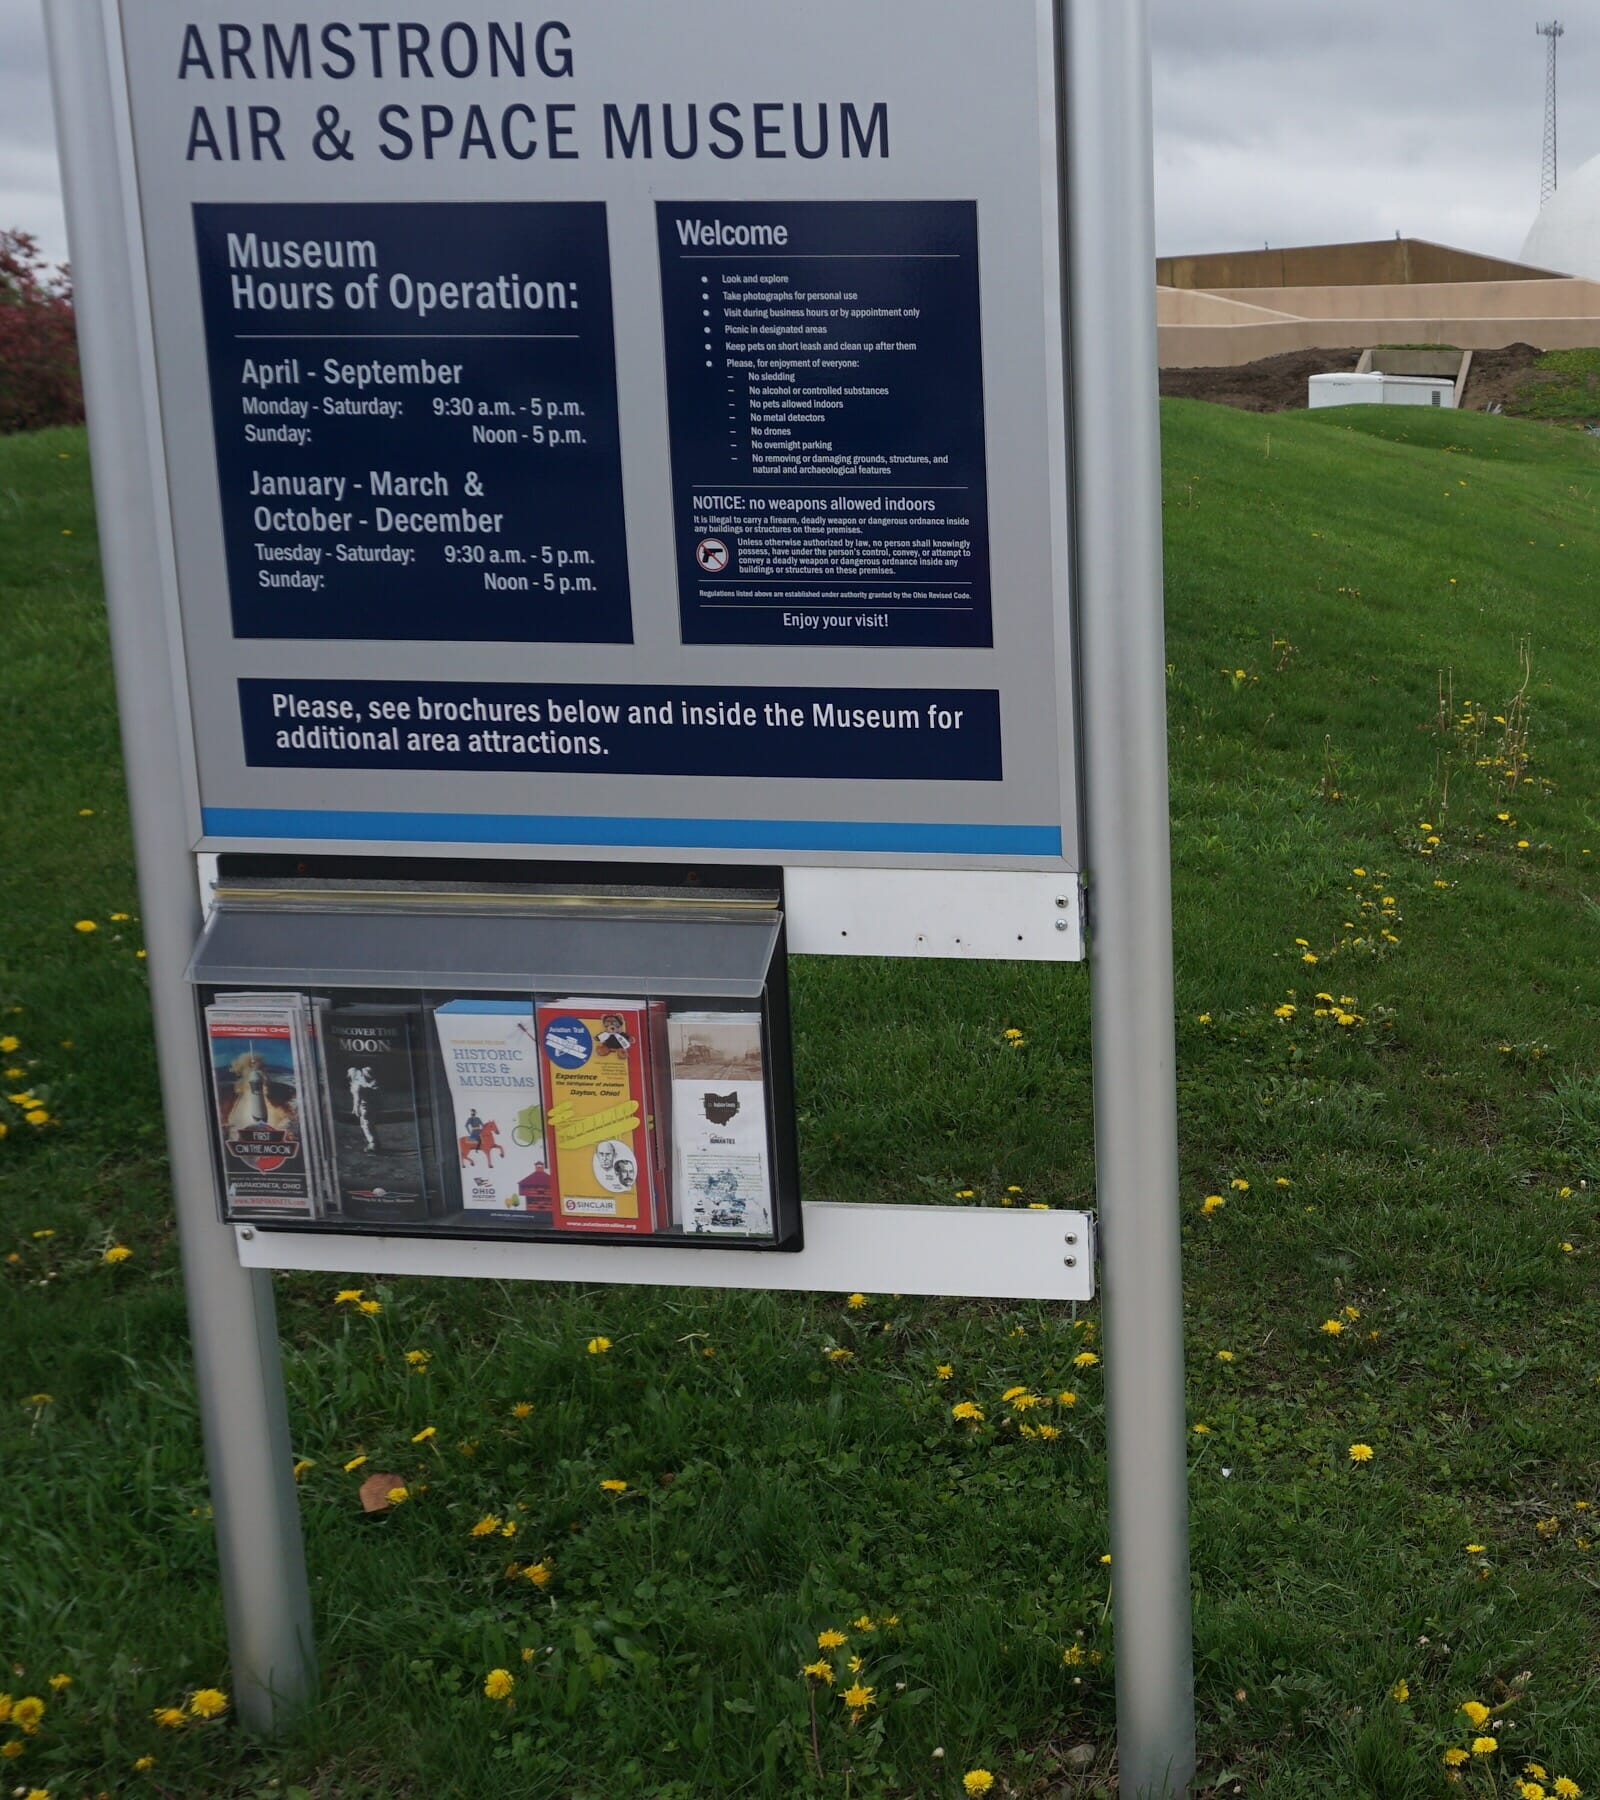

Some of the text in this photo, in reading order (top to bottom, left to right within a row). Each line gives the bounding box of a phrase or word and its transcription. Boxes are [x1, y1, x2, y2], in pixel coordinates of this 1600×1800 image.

[177, 20, 574, 80] ARMSTRONG
[185, 102, 889, 162] AIR & SPACE MUSEUM
[675, 219, 788, 246] Welcome
[226, 232, 377, 269] Museum
[721, 273, 789, 285] Look and explore
[231, 272, 578, 317] Hours of Operation:
[722, 290, 858, 303] Take photographs for personal use
[723, 307, 920, 319] Visit during business hours or by appointment only
[724, 324, 828, 336] Picnic in designated areas
[725, 340, 917, 353] Keep pets on short leash and clean up after them
[726, 358, 860, 370] Please, for enjoyment of everyone:
[241, 358, 300, 390] April
[323, 358, 463, 390] September
[748, 371, 796, 383] No sledding
[748, 385, 890, 395] No alcohol or controlled substances
[242, 396, 309, 419] Monday
[322, 396, 403, 419] Saturday:
[432, 397, 474, 416] 9:30
[477, 401, 516, 416] a.m.
[530, 397, 543, 416] 5
[546, 401, 585, 420] p.m.
[749, 399, 844, 410] No pets allowed indoors
[750, 412, 826, 422] No metal detectors
[244, 423, 312, 446] Sunday:
[472, 424, 518, 444] Noon
[532, 425, 545, 444] 5
[548, 429, 587, 448] p.m.
[750, 426, 792, 436] No drones
[751, 439, 833, 452] No overnight parking
[751, 453, 949, 467] No removing or damaging grounds, structures, and
[752, 464, 892, 476] natural and archaeological features
[249, 470, 346, 502] January
[369, 470, 449, 497] March
[464, 470, 485, 497] &
[692, 495, 936, 513] NOTICE: no weapons allowed indoors
[254, 506, 353, 532] October
[375, 507, 504, 533] December
[254, 543, 322, 565] Tuesday
[335, 543, 416, 566] Saturday:
[444, 544, 485, 563] 9:30
[489, 549, 526, 564] a.m.
[541, 545, 553, 564] 5
[557, 550, 595, 568] p.m.
[258, 569, 325, 592] Sunday:
[483, 572, 529, 591] Noon
[543, 572, 555, 591] 5
[559, 577, 597, 595] p.m.
[783, 612, 889, 630] Enjoy your visit!
[272, 693, 963, 729] Please, see brochures below and inside the Museum for
[276, 725, 609, 755] additional area attractions.
[453, 1048, 523, 1060] HISTORIC
[456, 1063, 511, 1073] SITES &
[459, 1076, 535, 1087] MUSEUMS
